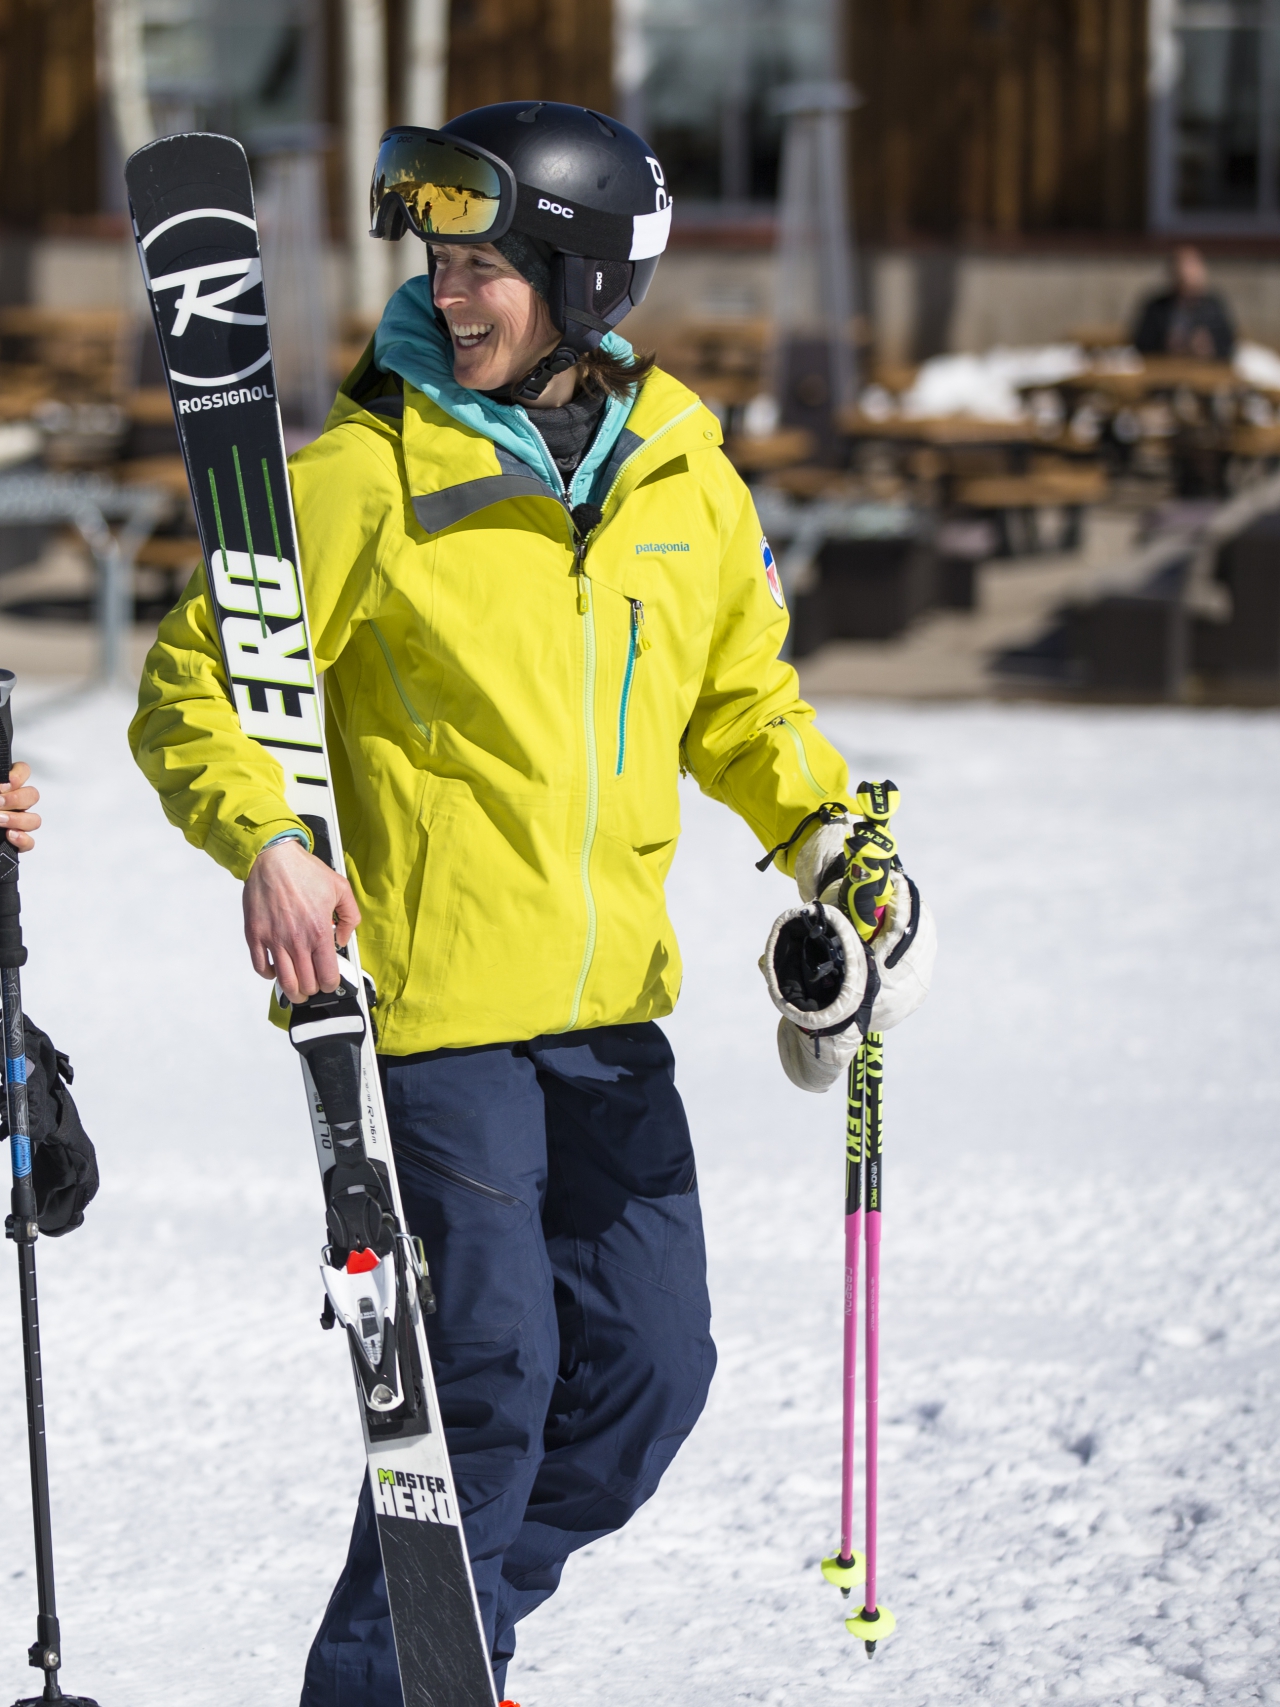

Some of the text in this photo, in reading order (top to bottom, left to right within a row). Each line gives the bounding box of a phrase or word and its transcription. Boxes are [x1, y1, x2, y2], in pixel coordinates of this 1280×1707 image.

[178, 384, 274, 415] ROSSIGNOL
[634, 541, 690, 555] patagonia
[872, 782, 886, 813] LEKI
[857, 828, 894, 850] LEKI
[866, 1031, 884, 1078] EKI
[846, 1097, 862, 1163] LEKI
[870, 1161, 878, 1208] VENOM RACE
[377, 1467, 447, 1494] MASTER
[375, 1483, 459, 1527] HERO
